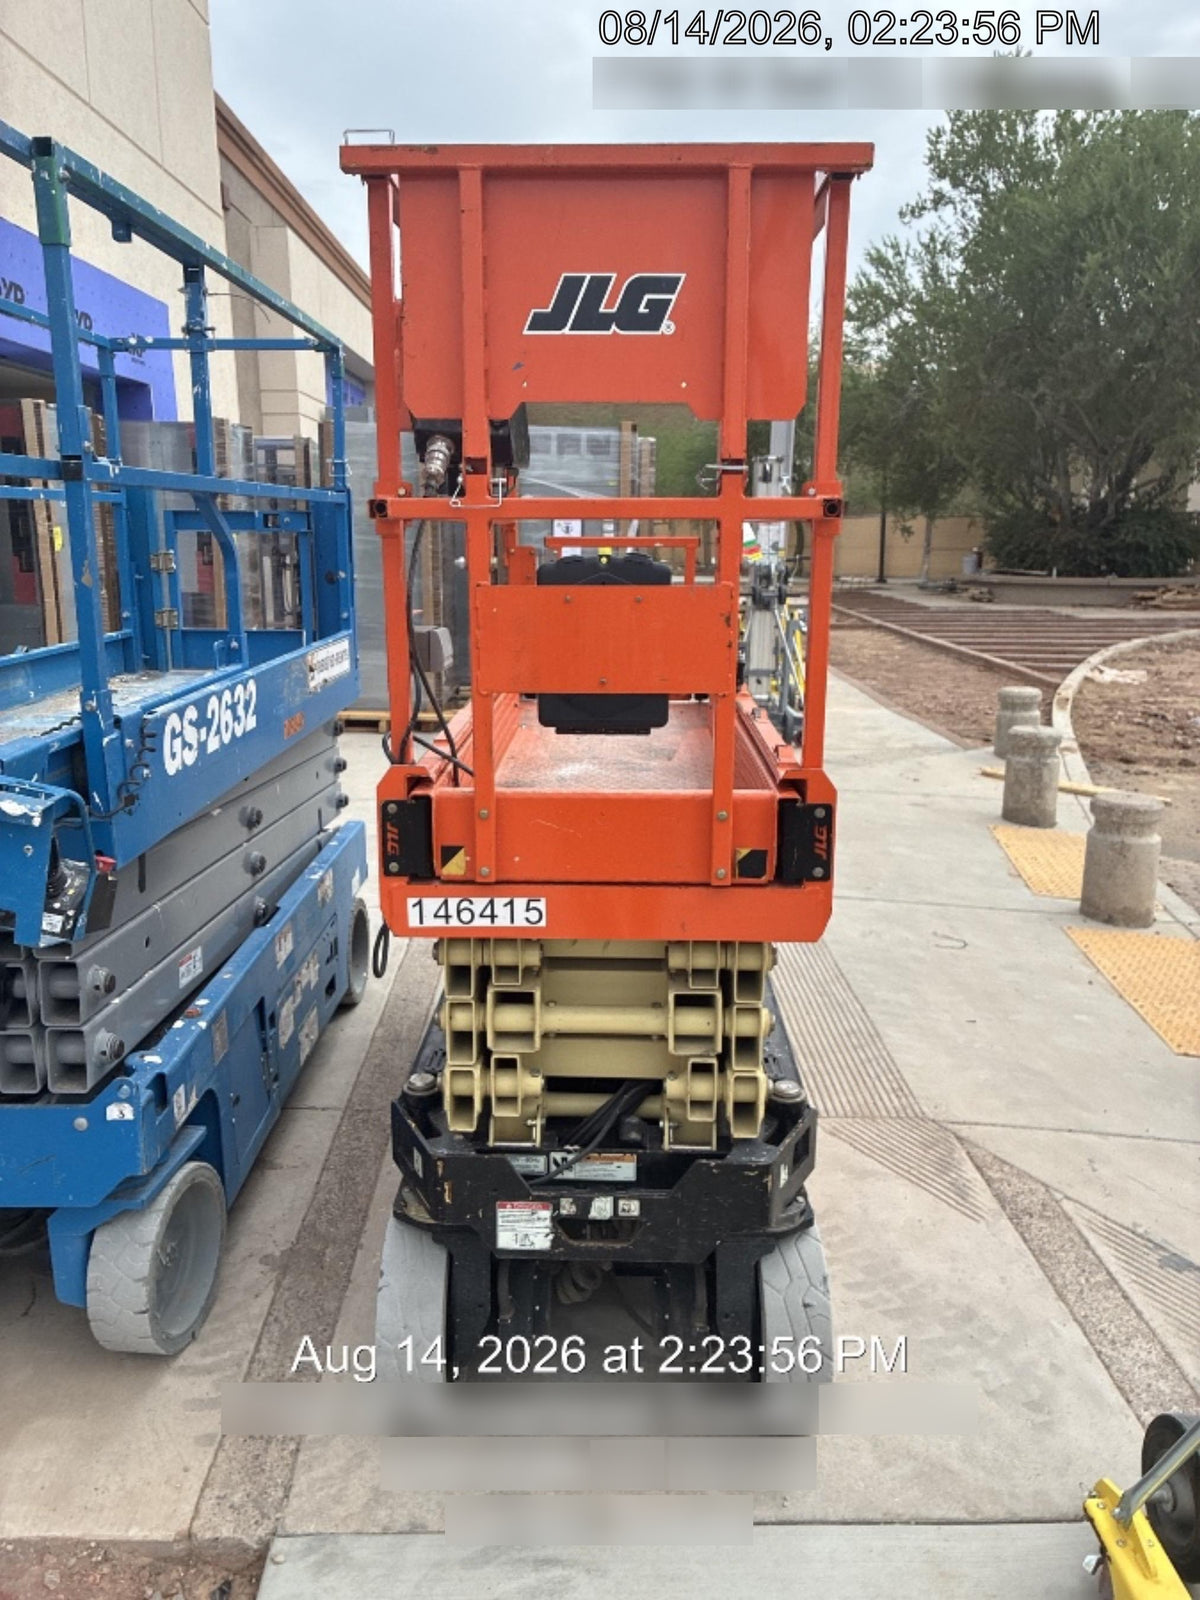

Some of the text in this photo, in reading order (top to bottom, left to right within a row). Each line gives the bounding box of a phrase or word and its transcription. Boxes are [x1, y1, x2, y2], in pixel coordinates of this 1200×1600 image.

[523, 272, 687, 335] JLG
[163, 678, 257, 776] GS-2632
[386, 821, 399, 856] JLG
[813, 825, 828, 860] JLG
[411, 897, 544, 926] 146415
